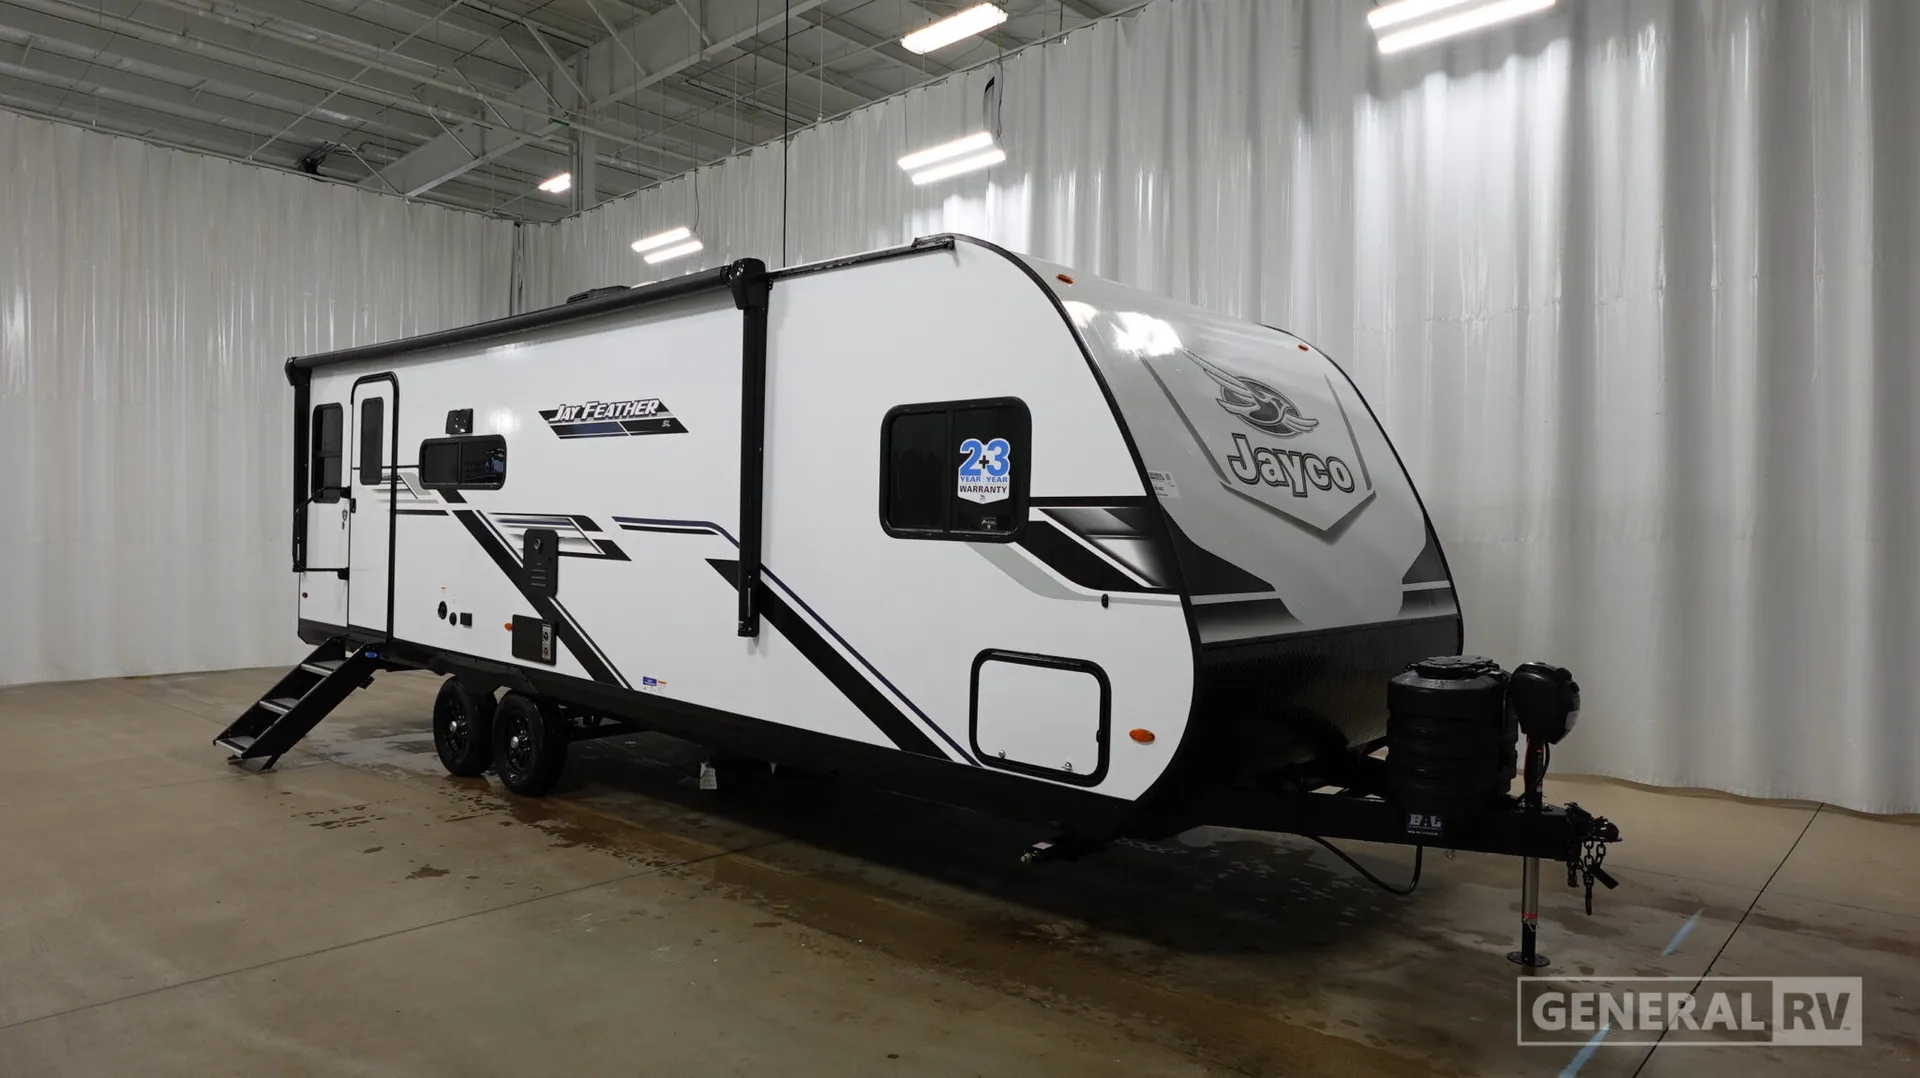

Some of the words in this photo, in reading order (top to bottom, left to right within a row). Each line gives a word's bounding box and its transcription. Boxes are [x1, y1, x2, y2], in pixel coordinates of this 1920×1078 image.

[549, 404, 581, 423] JAY
[581, 399, 660, 421] FEATHER
[1227, 432, 1355, 498] Jayco
[960, 485, 1007, 493] WARRANTY
[1410, 814, 1441, 827] BL
